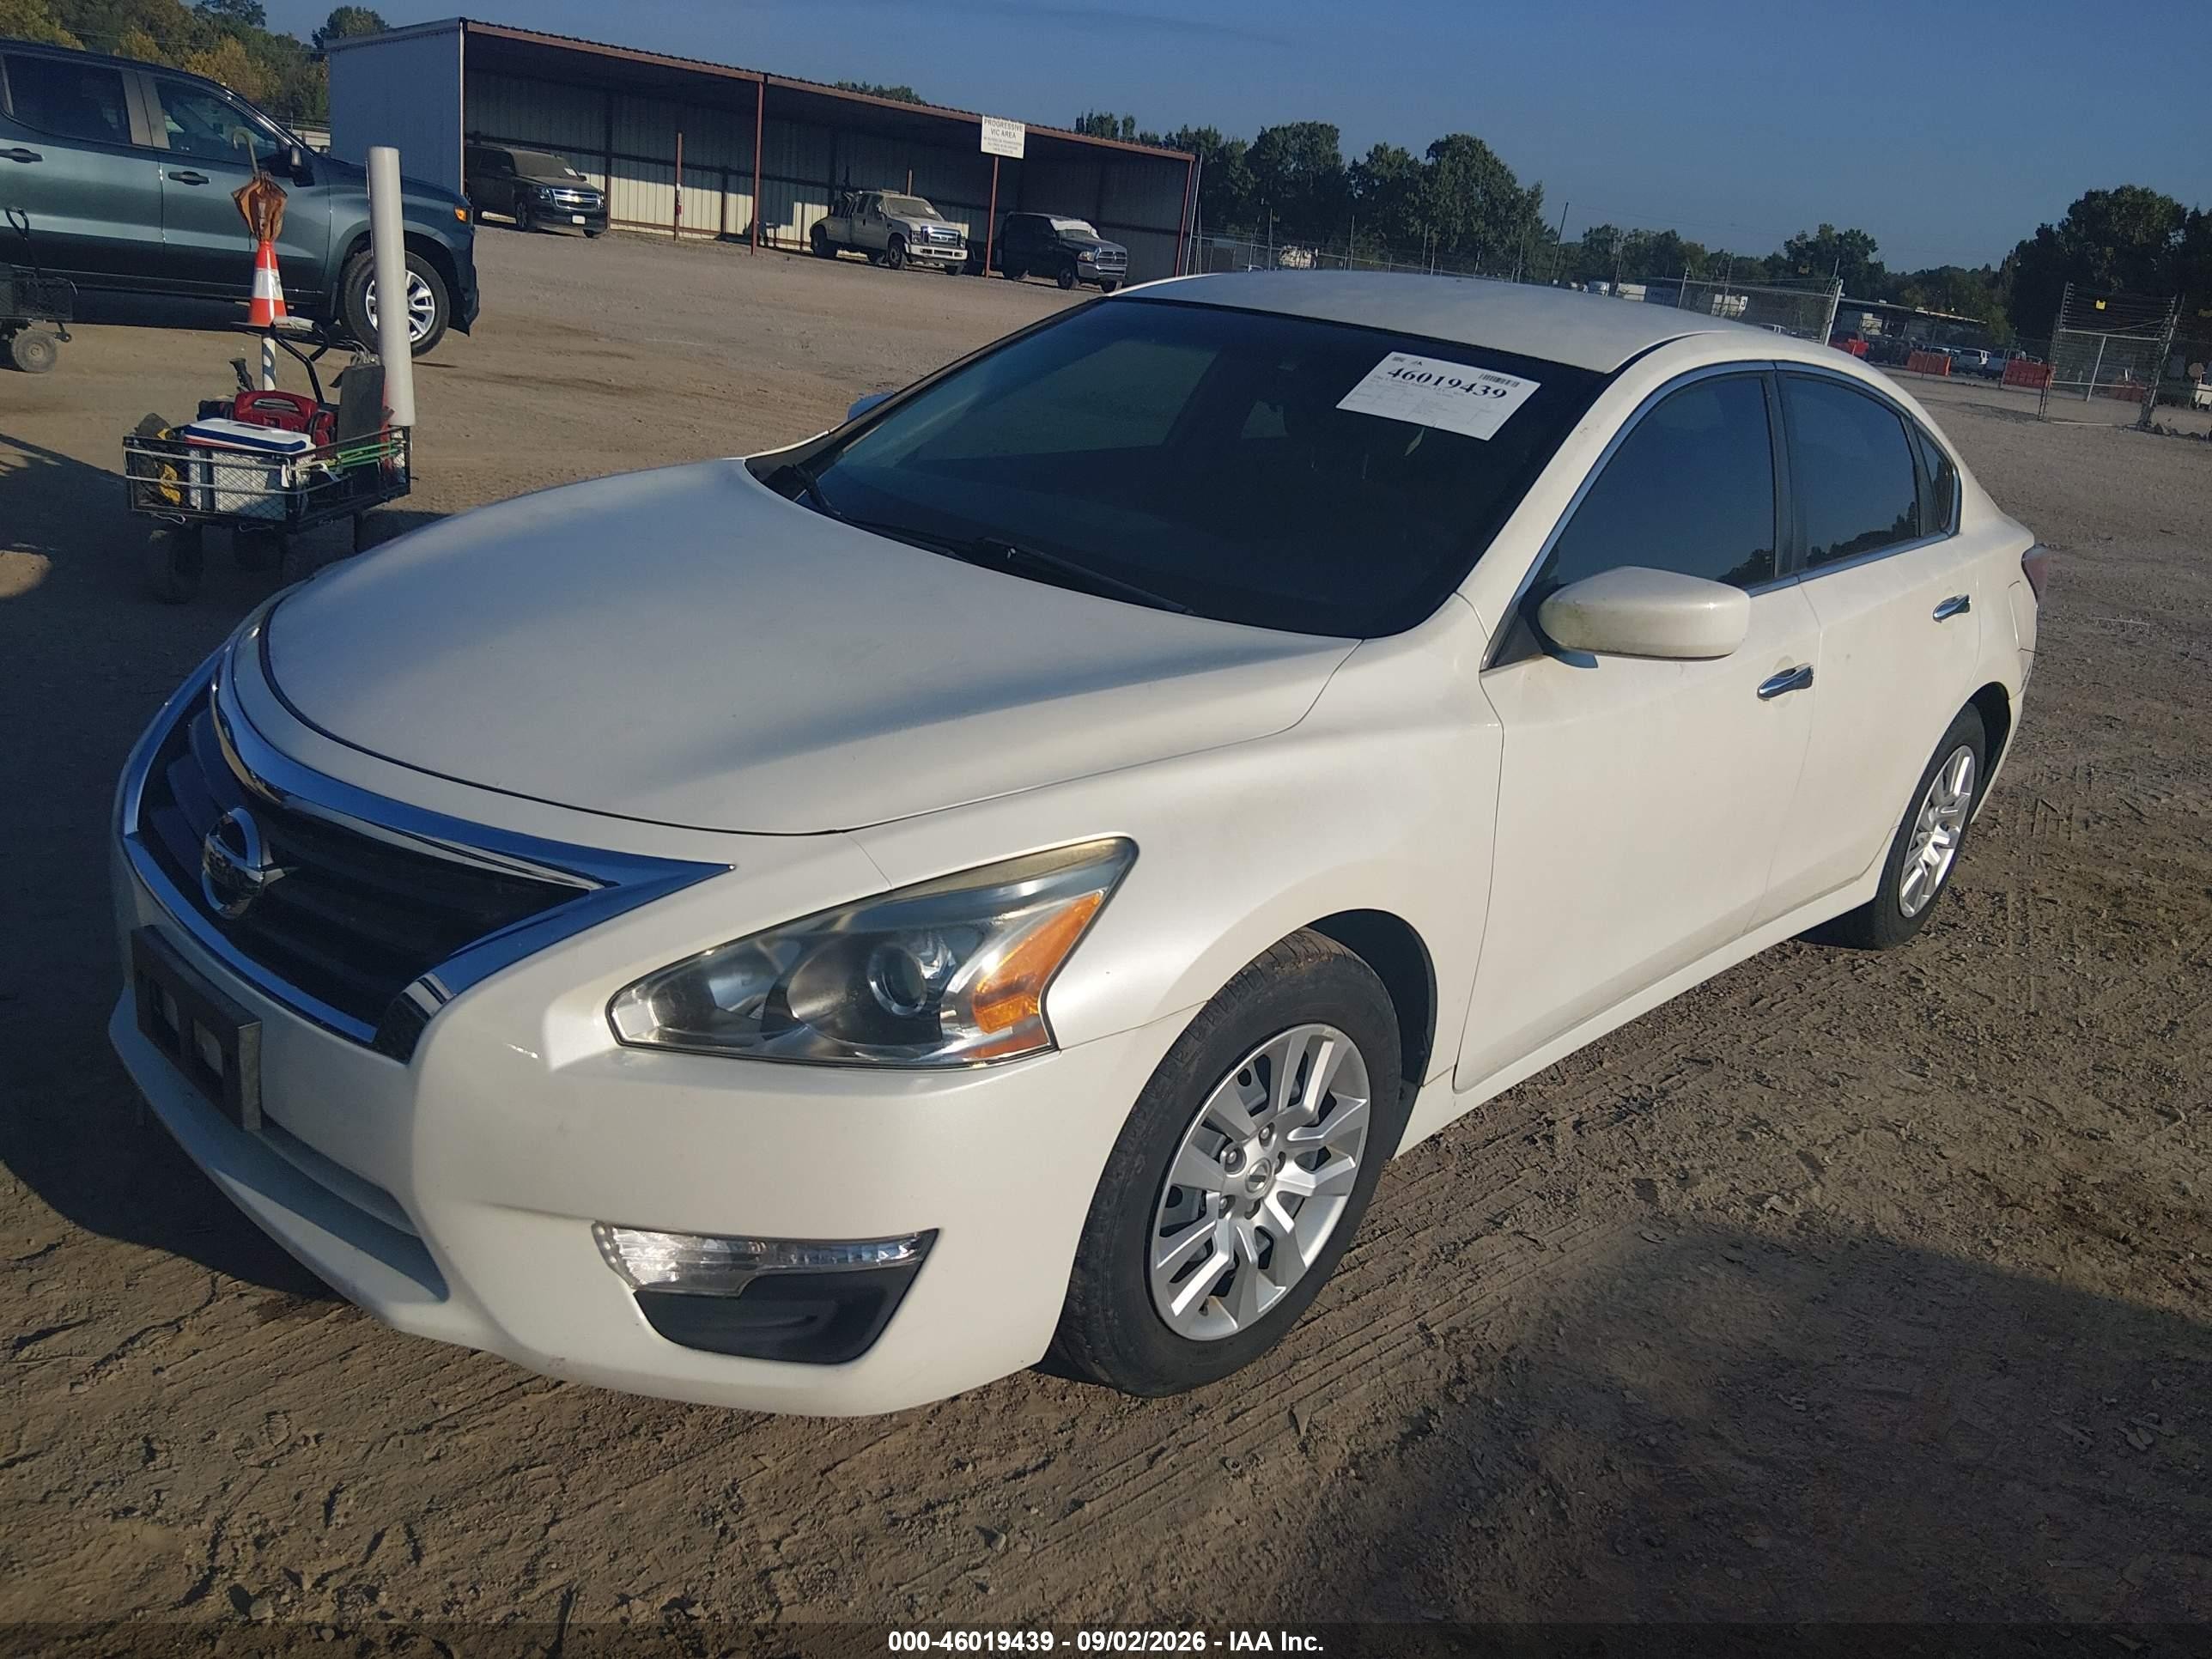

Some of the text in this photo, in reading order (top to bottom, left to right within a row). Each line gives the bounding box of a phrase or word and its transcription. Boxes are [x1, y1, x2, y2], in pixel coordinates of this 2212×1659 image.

[984, 118, 1024, 131] PROGRESSIVE
[991, 128, 1017, 139] VIC AREA
[1387, 368, 1508, 399] 46019439
